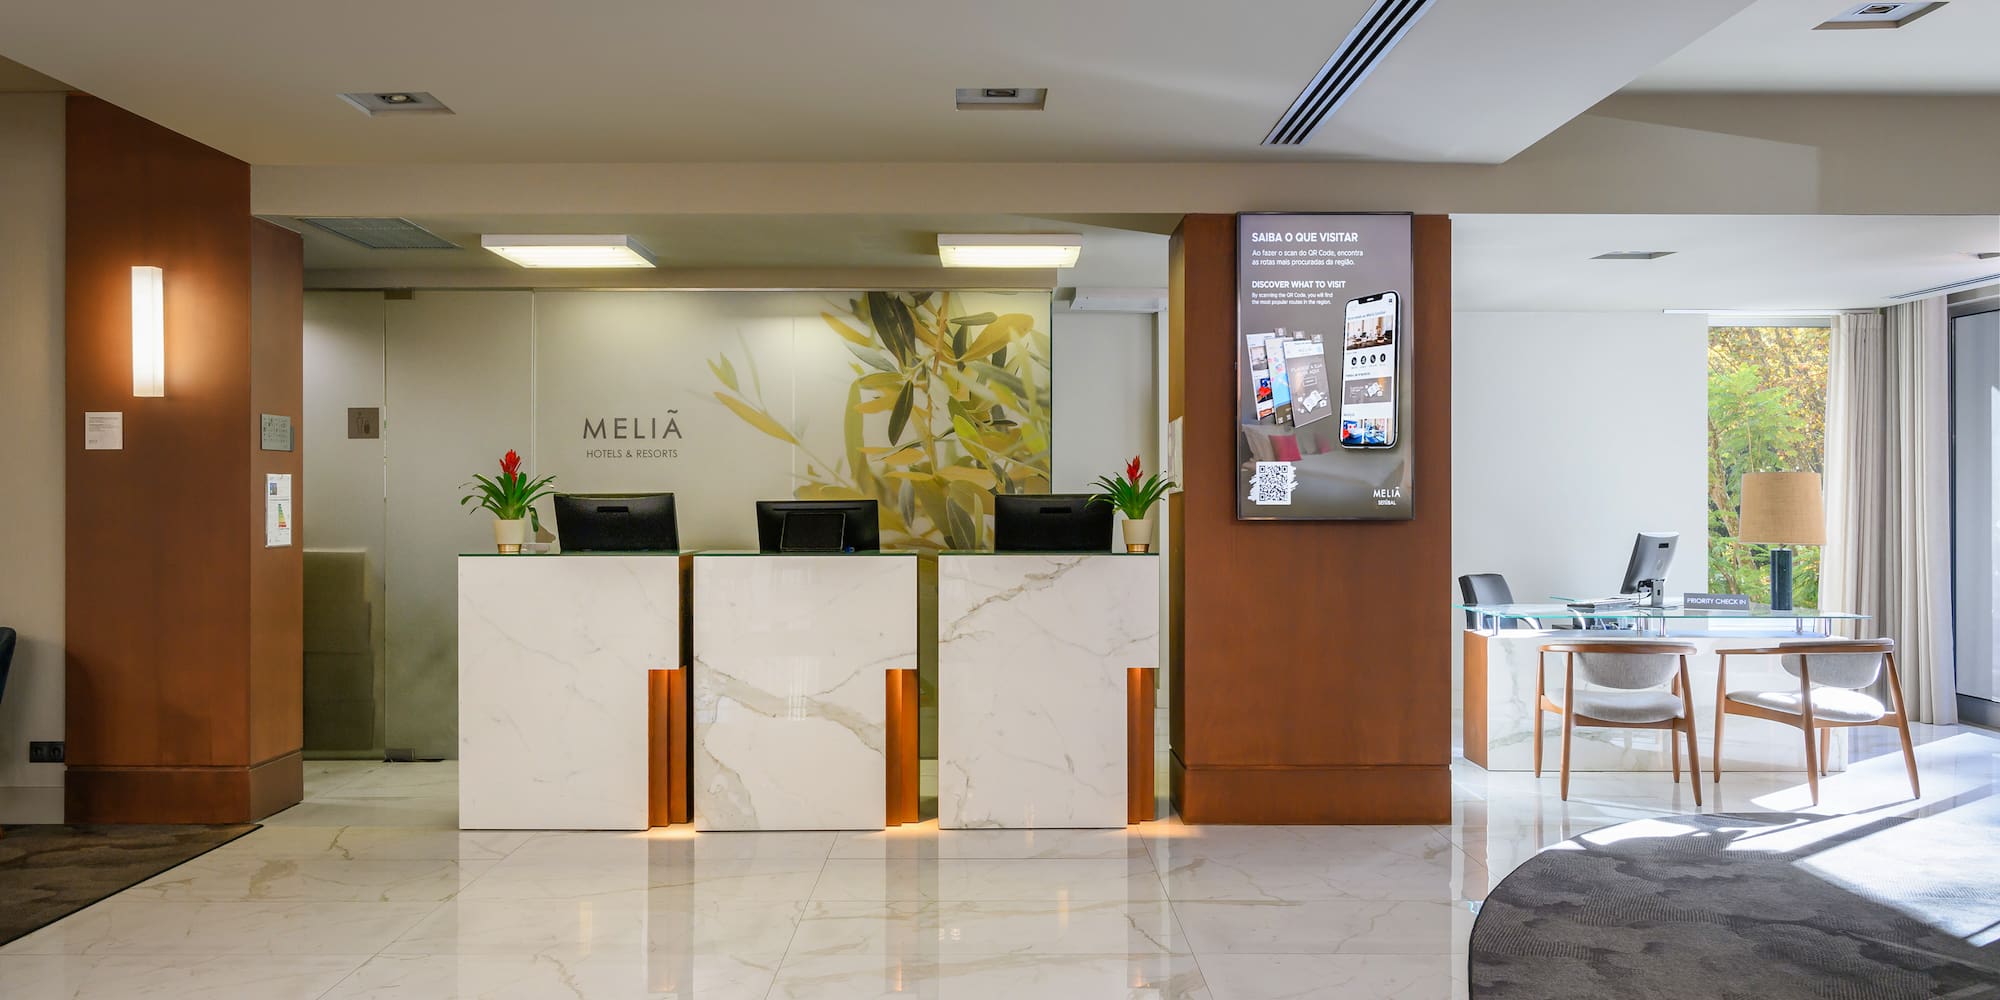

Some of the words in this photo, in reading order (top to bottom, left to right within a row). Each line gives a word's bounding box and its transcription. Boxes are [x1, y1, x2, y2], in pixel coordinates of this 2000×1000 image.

[1252, 232, 1282, 242] SAIBA
[1284, 232, 1293, 242] O
[1295, 232, 1318, 242] QUE
[1319, 232, 1358, 242] VISITAR
[1292, 259, 1324, 267] procuradas
[1334, 258, 1354, 267] região.
[583, 409, 682, 439] MELIÃ
[586, 450, 622, 458] HOTELS
[626, 450, 633, 458] &
[636, 450, 678, 458] RESORTS
[1373, 486, 1400, 498] MELIÃ
